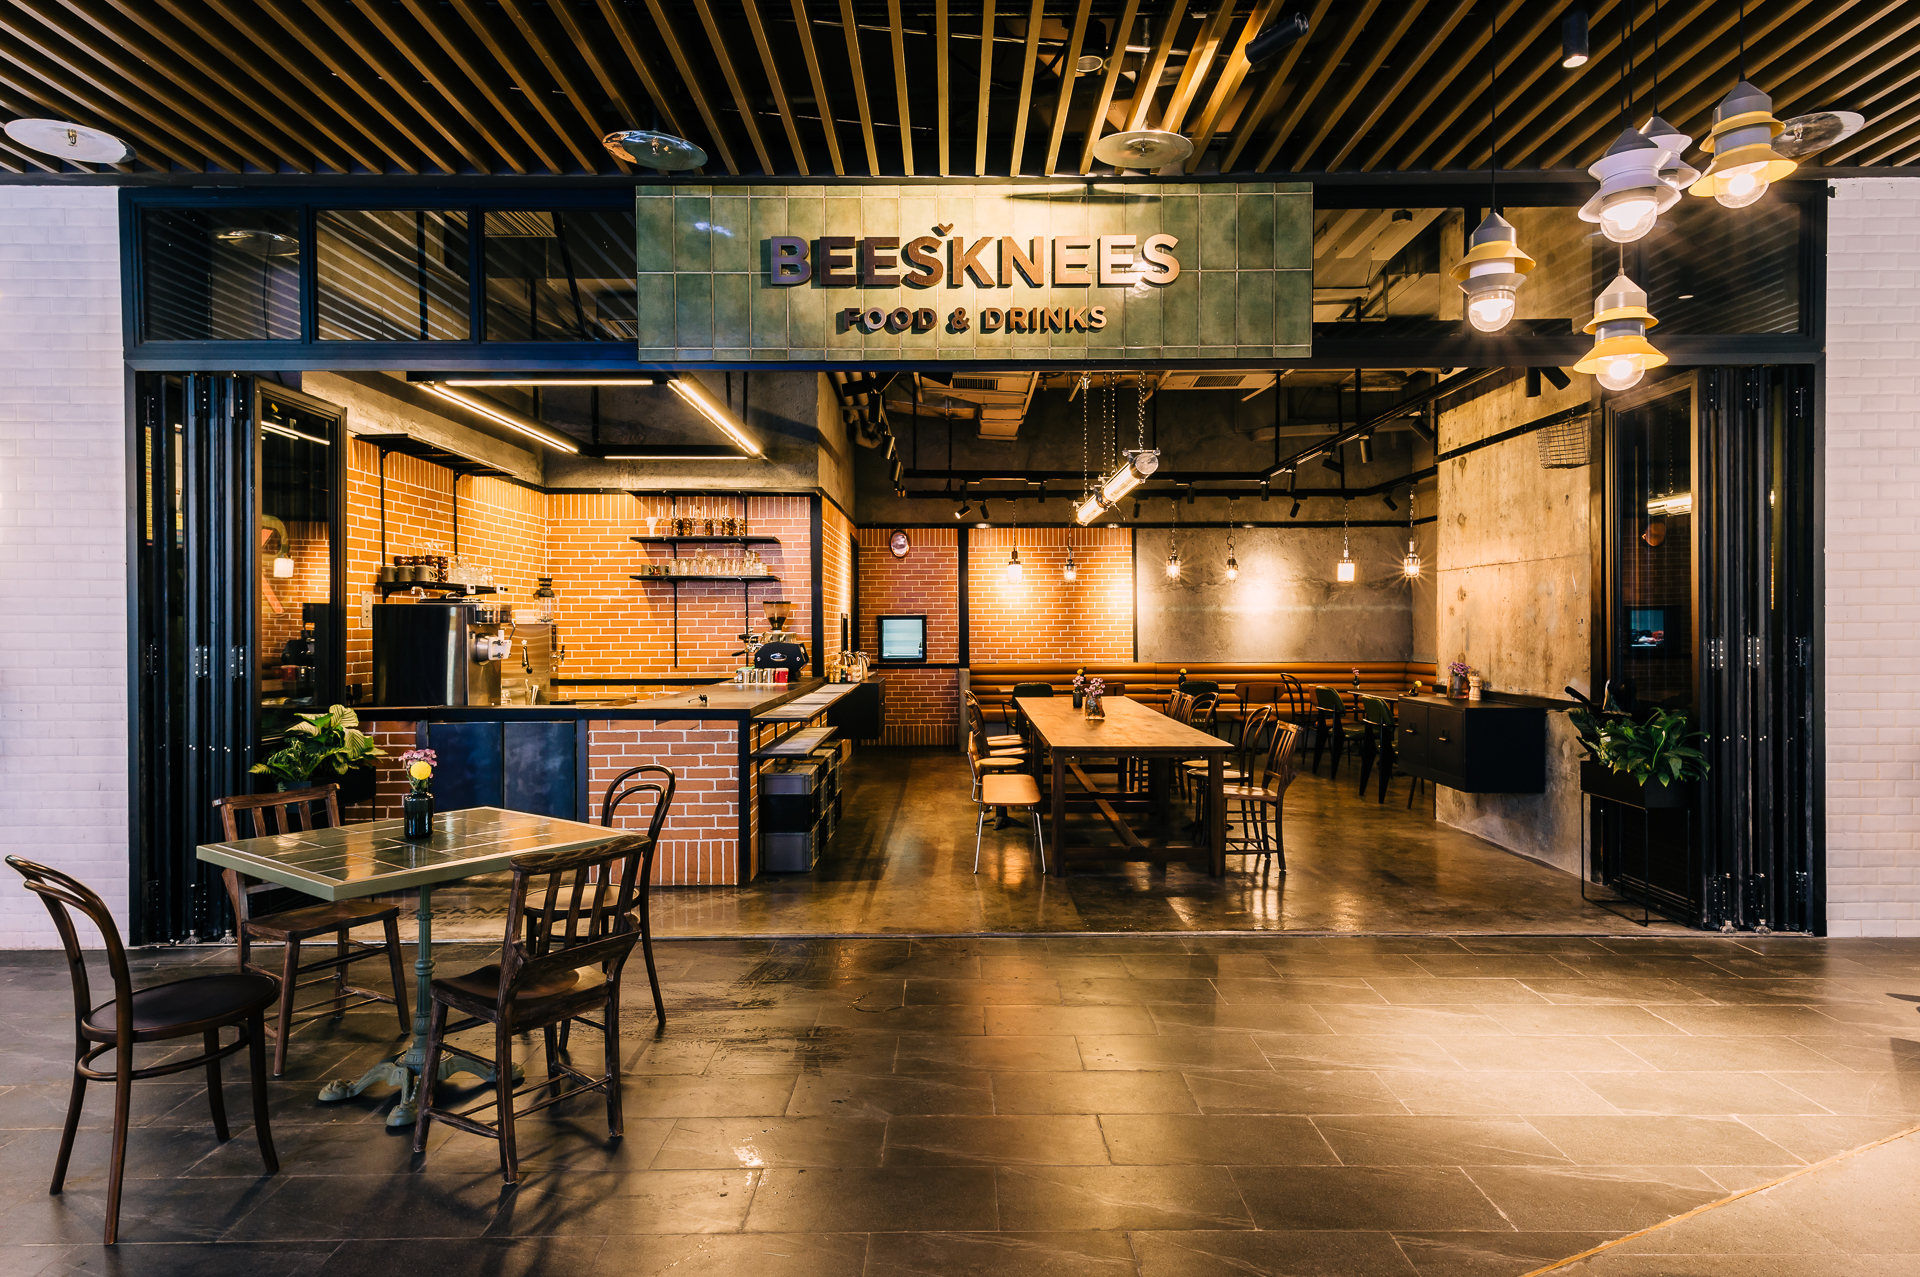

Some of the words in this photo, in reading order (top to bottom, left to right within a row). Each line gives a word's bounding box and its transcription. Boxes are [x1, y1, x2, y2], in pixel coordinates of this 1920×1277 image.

[769, 222, 1181, 287] BEEŠKNEES
[843, 306, 938, 331] FOOD
[951, 306, 972, 331] &
[984, 305, 1108, 330] DRINKS
